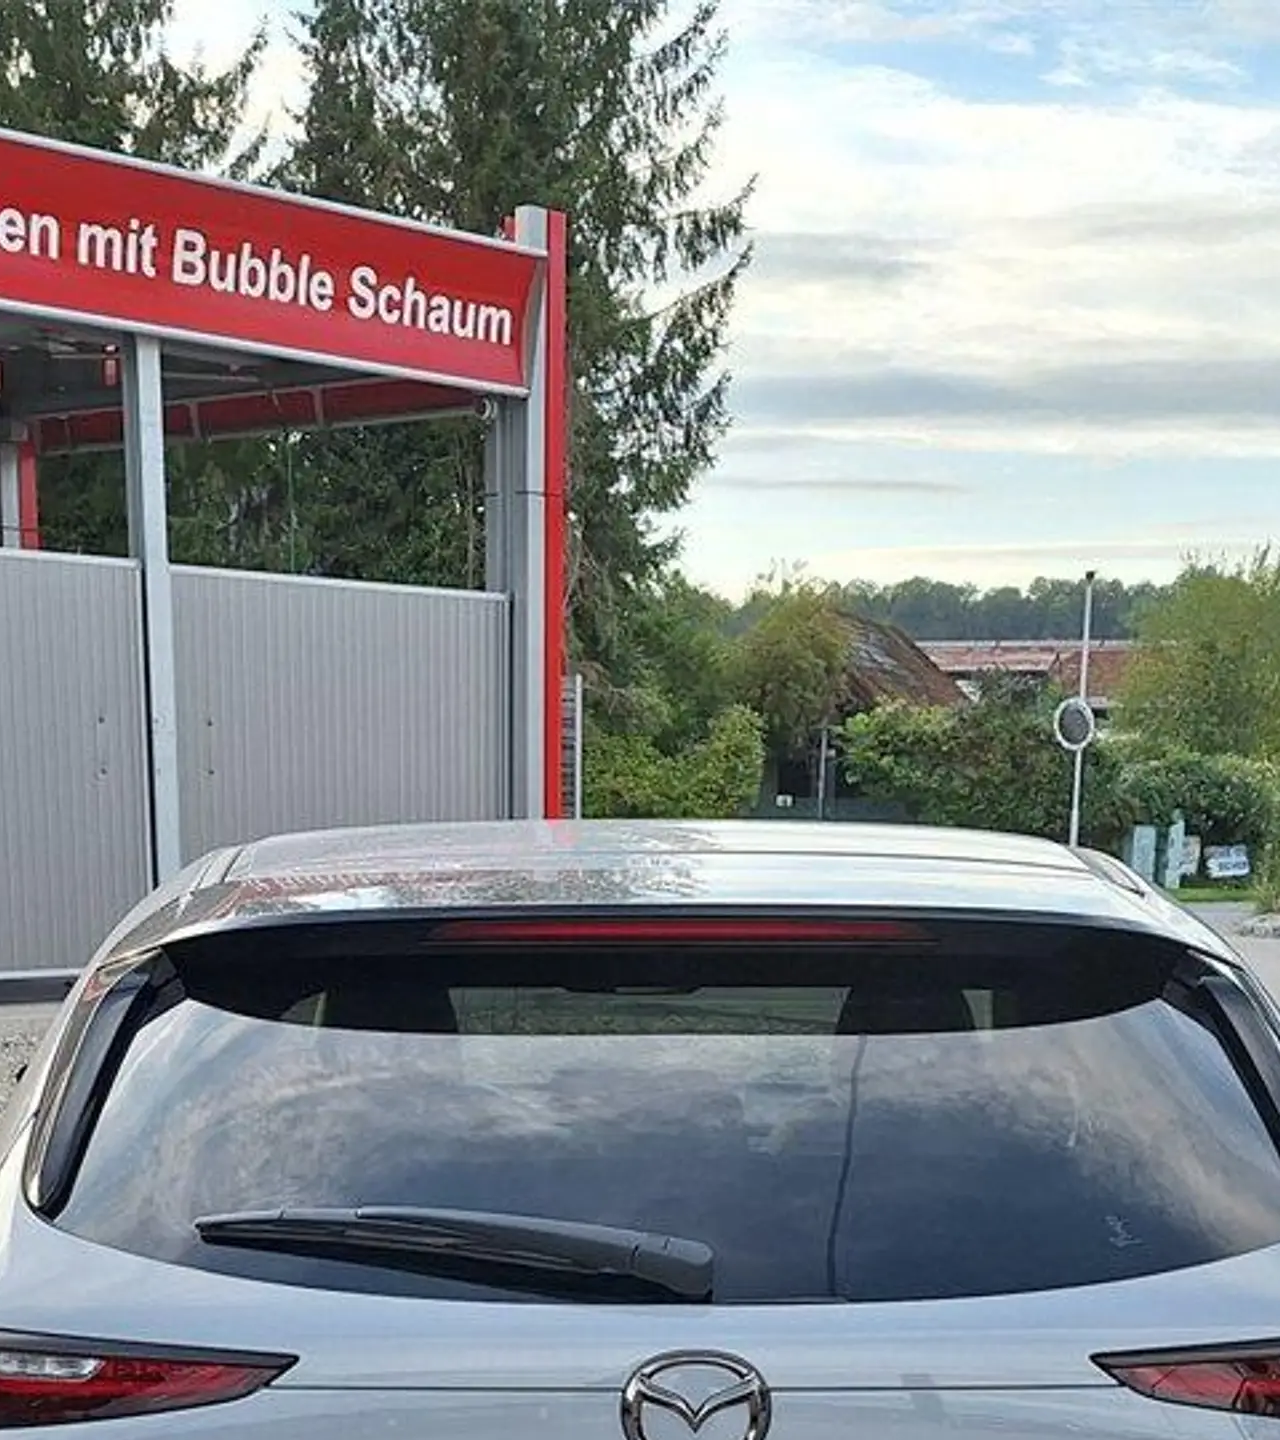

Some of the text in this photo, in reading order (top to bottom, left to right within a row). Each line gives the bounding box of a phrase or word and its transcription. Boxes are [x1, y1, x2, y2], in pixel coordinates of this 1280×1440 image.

[77, 218, 159, 278] mit
[171, 229, 335, 312] Bubble
[348, 265, 513, 345] Schaum
